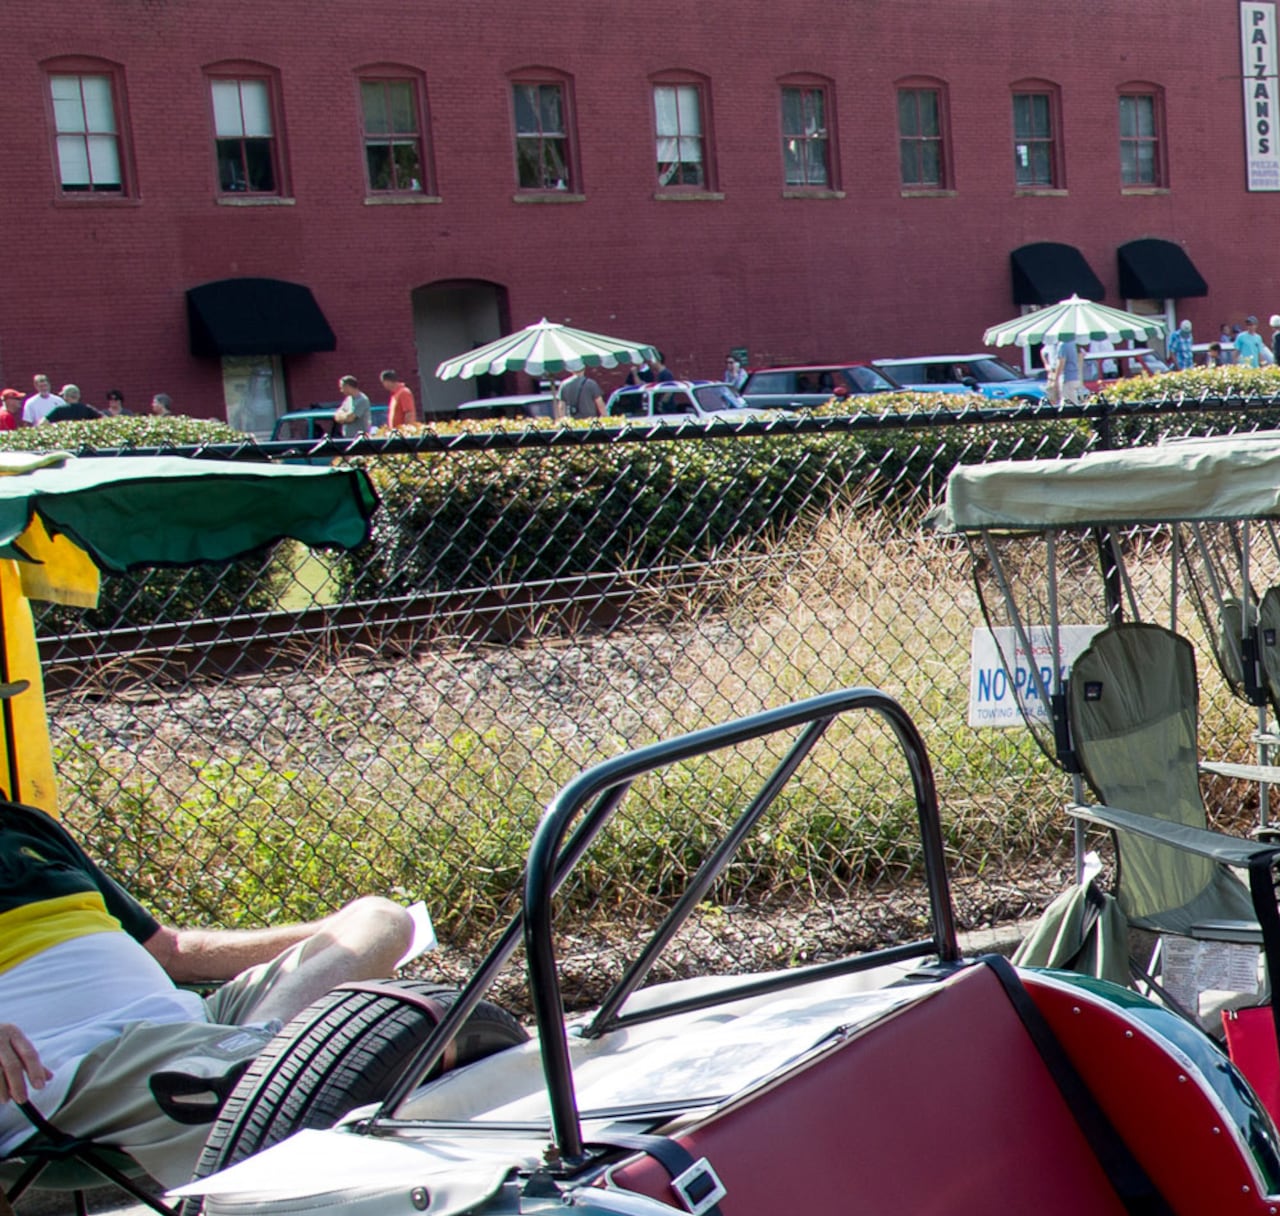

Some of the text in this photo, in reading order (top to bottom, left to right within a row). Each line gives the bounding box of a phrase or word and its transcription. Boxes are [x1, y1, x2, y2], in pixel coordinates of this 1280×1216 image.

[1251, 10, 1270, 154] PAIZANOS
[978, 667, 1007, 702] NO
[977, 707, 1013, 719] TOWING
